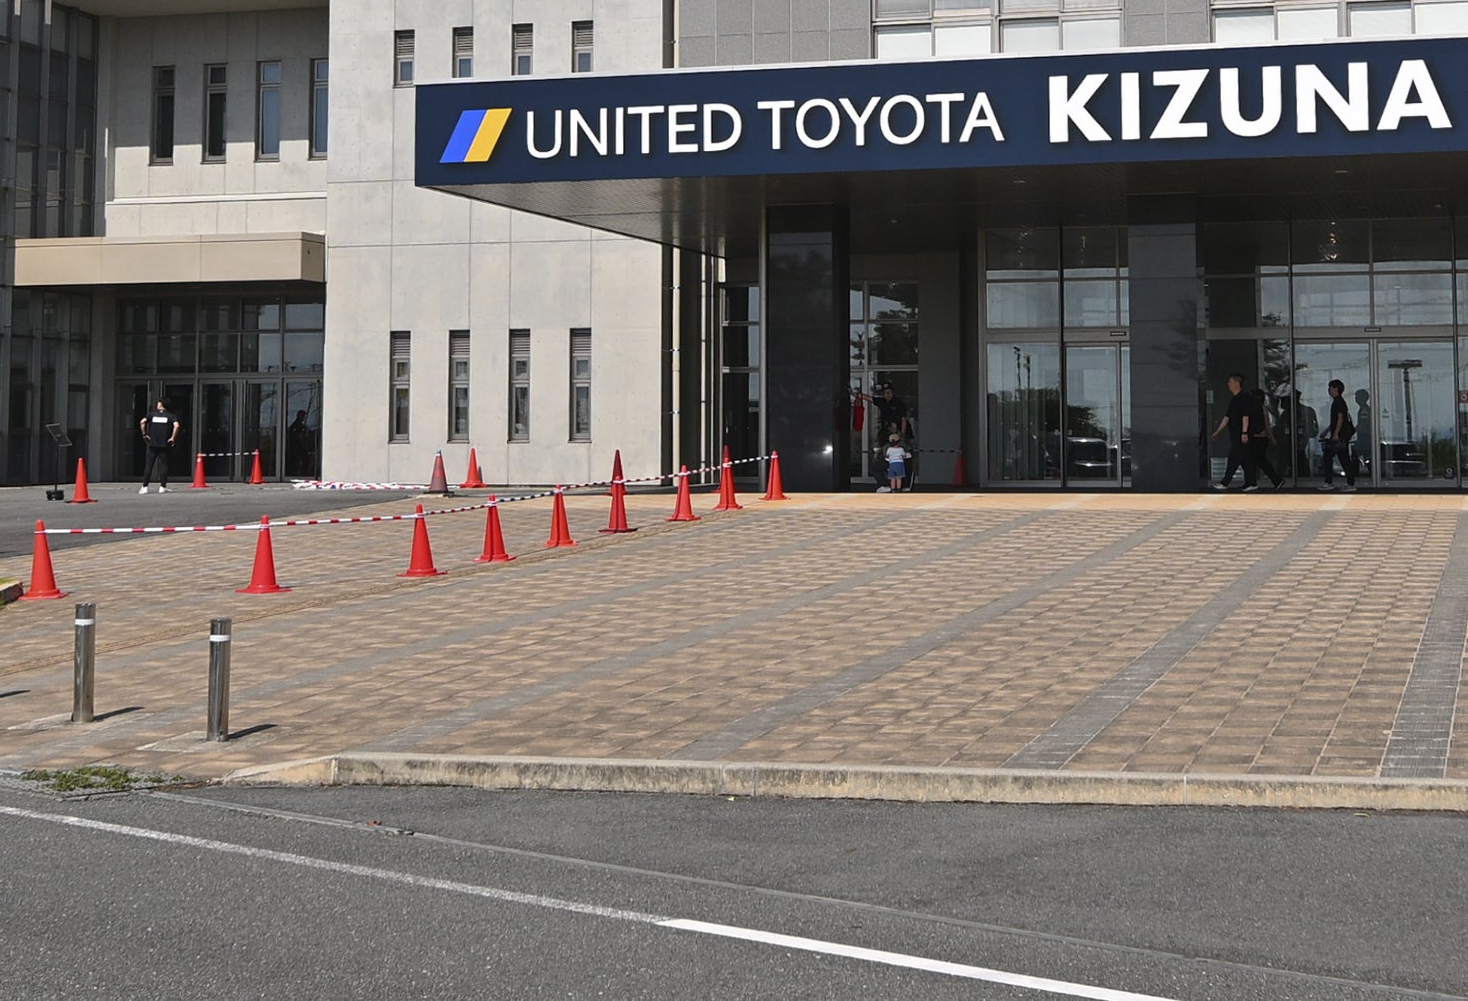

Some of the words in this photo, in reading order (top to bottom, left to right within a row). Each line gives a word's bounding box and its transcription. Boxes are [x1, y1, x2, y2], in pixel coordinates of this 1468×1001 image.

[525, 102, 742, 160] UNITED
[757, 91, 1005, 151] TOYOTA
[1048, 59, 1453, 143] KIZUNA
